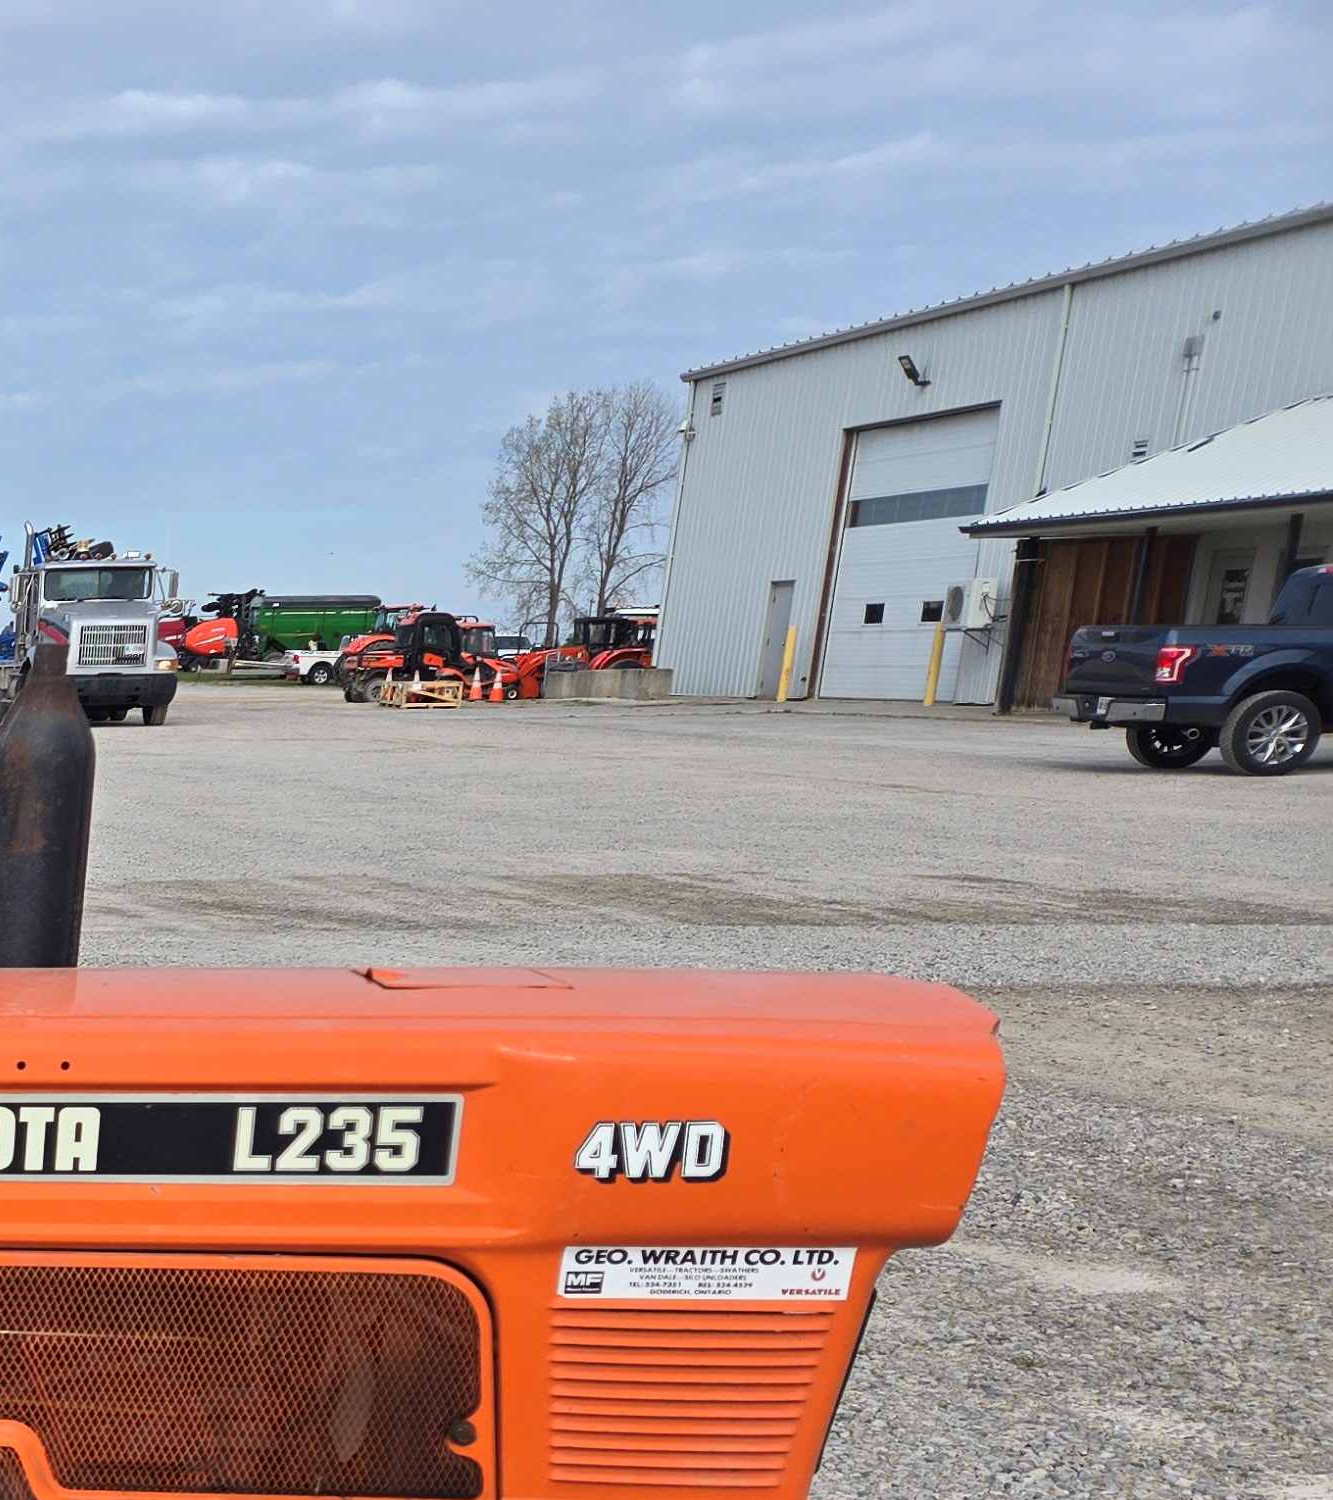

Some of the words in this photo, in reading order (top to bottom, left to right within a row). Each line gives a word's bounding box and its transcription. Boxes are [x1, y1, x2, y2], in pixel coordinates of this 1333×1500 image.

[234, 1106, 425, 1172] L235
[574, 1121, 730, 1183] 4WD
[575, 1249, 633, 1265] GEO.
[641, 1249, 738, 1265] WRAITH
[744, 1249, 786, 1265] CO.
[793, 1249, 840, 1266] LTD.
[567, 1273, 603, 1286] MF
[781, 1288, 841, 1296] VERSATILE
